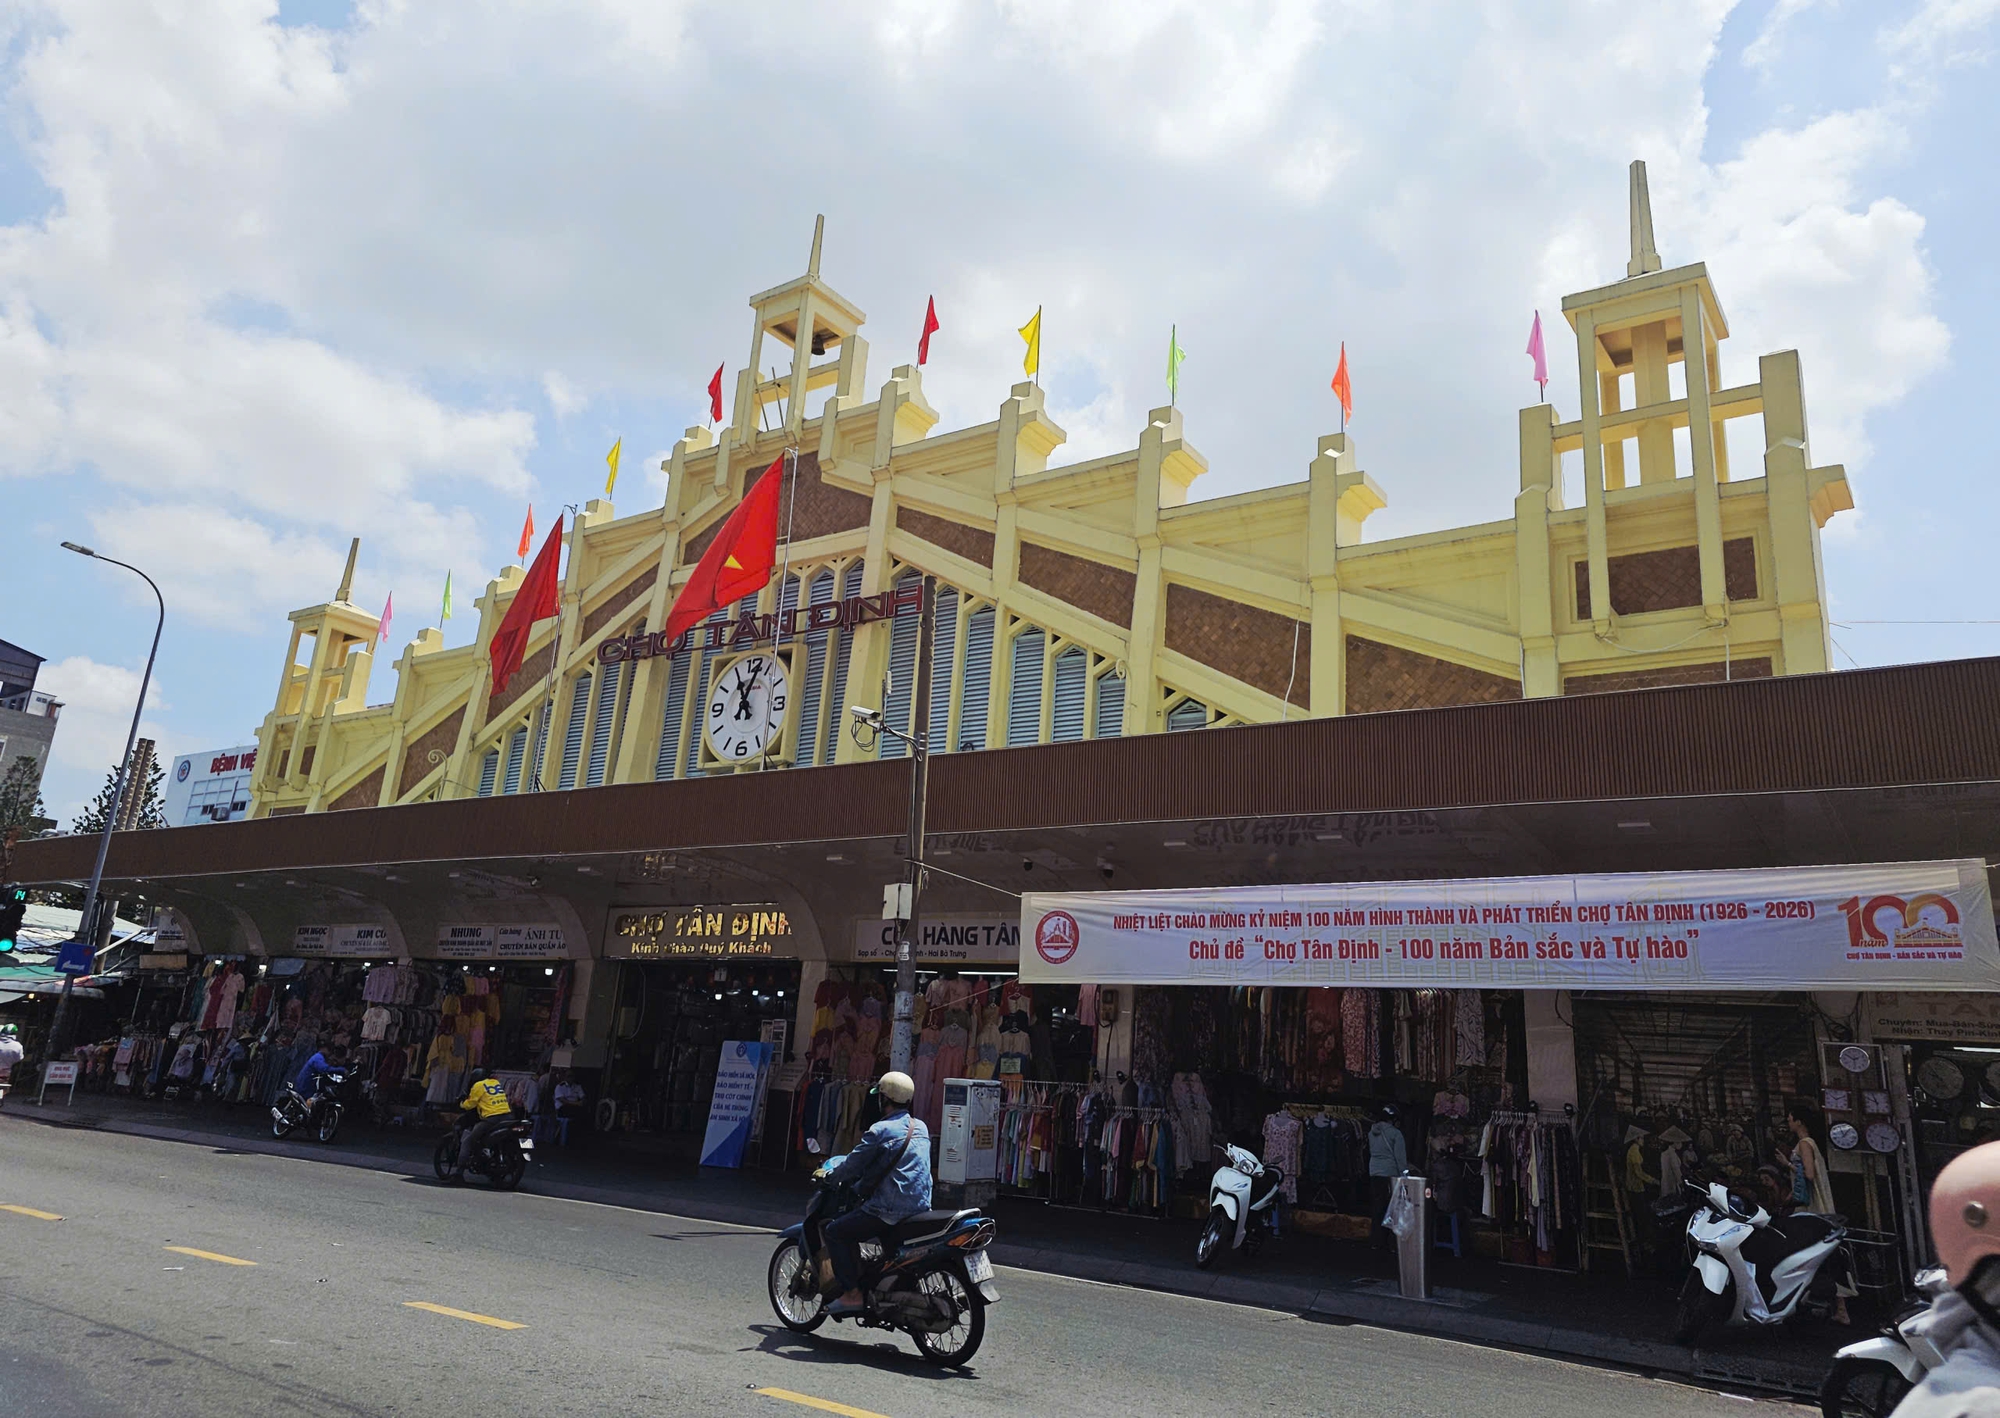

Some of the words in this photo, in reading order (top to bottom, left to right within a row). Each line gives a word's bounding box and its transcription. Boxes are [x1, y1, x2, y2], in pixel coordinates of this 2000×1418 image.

[597, 629, 687, 665] CHỢ
[704, 611, 797, 646] TÂN
[810, 585, 923, 631] ĐỊNH
[712, 703, 724, 717] 9
[773, 696, 785, 711] 3
[735, 741, 747, 756] 6
[210, 753, 238, 776] BỆNH
[1113, 913, 1145, 932] NHIỆT
[1148, 913, 1171, 932] LIỆT
[1175, 911, 1206, 929] CHÀO
[1210, 911, 1246, 928] MỪNG
[1249, 908, 1266, 928] KỶ
[1269, 910, 1302, 931] NIỆM
[1307, 911, 1329, 927] 100
[1333, 908, 1364, 926] NĂM
[1369, 908, 1402, 926] HÌNH
[1407, 906, 1454, 925] THÀNH
[1458, 906, 1478, 925] VÀ
[1482, 905, 1523, 924] PHÁT
[1525, 900, 1572, 923] TRIỂN
[1578, 903, 1611, 926] CHỢ
[1615, 901, 1649, 921] TÂN
[1653, 904, 1693, 924] ĐỊNH
[1700, 903, 1747, 922] (1926
[1766, 900, 1815, 921] 2026)
[1837, 894, 1959, 947] 100
[615, 910, 668, 941] CHỢ
[675, 907, 723, 936] TÂN
[357, 929, 373, 938] KIM
[451, 928, 481, 937] NHUNG
[923, 922, 978, 945] HÀNG
[631, 942, 659, 953] Kính
[728, 941, 772, 954] Khách
[1189, 938, 1218, 960] Chủ
[1225, 937, 1244, 960] đề
[1301, 939, 1333, 959] Tân
[1338, 939, 1379, 963] Định
[1398, 939, 1433, 959] 100
[1440, 937, 1482, 958] năm
[1489, 935, 1529, 958] Bản
[1536, 932, 1574, 958] sắc
[1580, 937, 1606, 958] và
[1612, 937, 1641, 964] Tự
[1859, 938, 1887, 948] năm
[950, 949, 966, 958] Trưng
[1927, 1028, 1952, 1037] Thay
